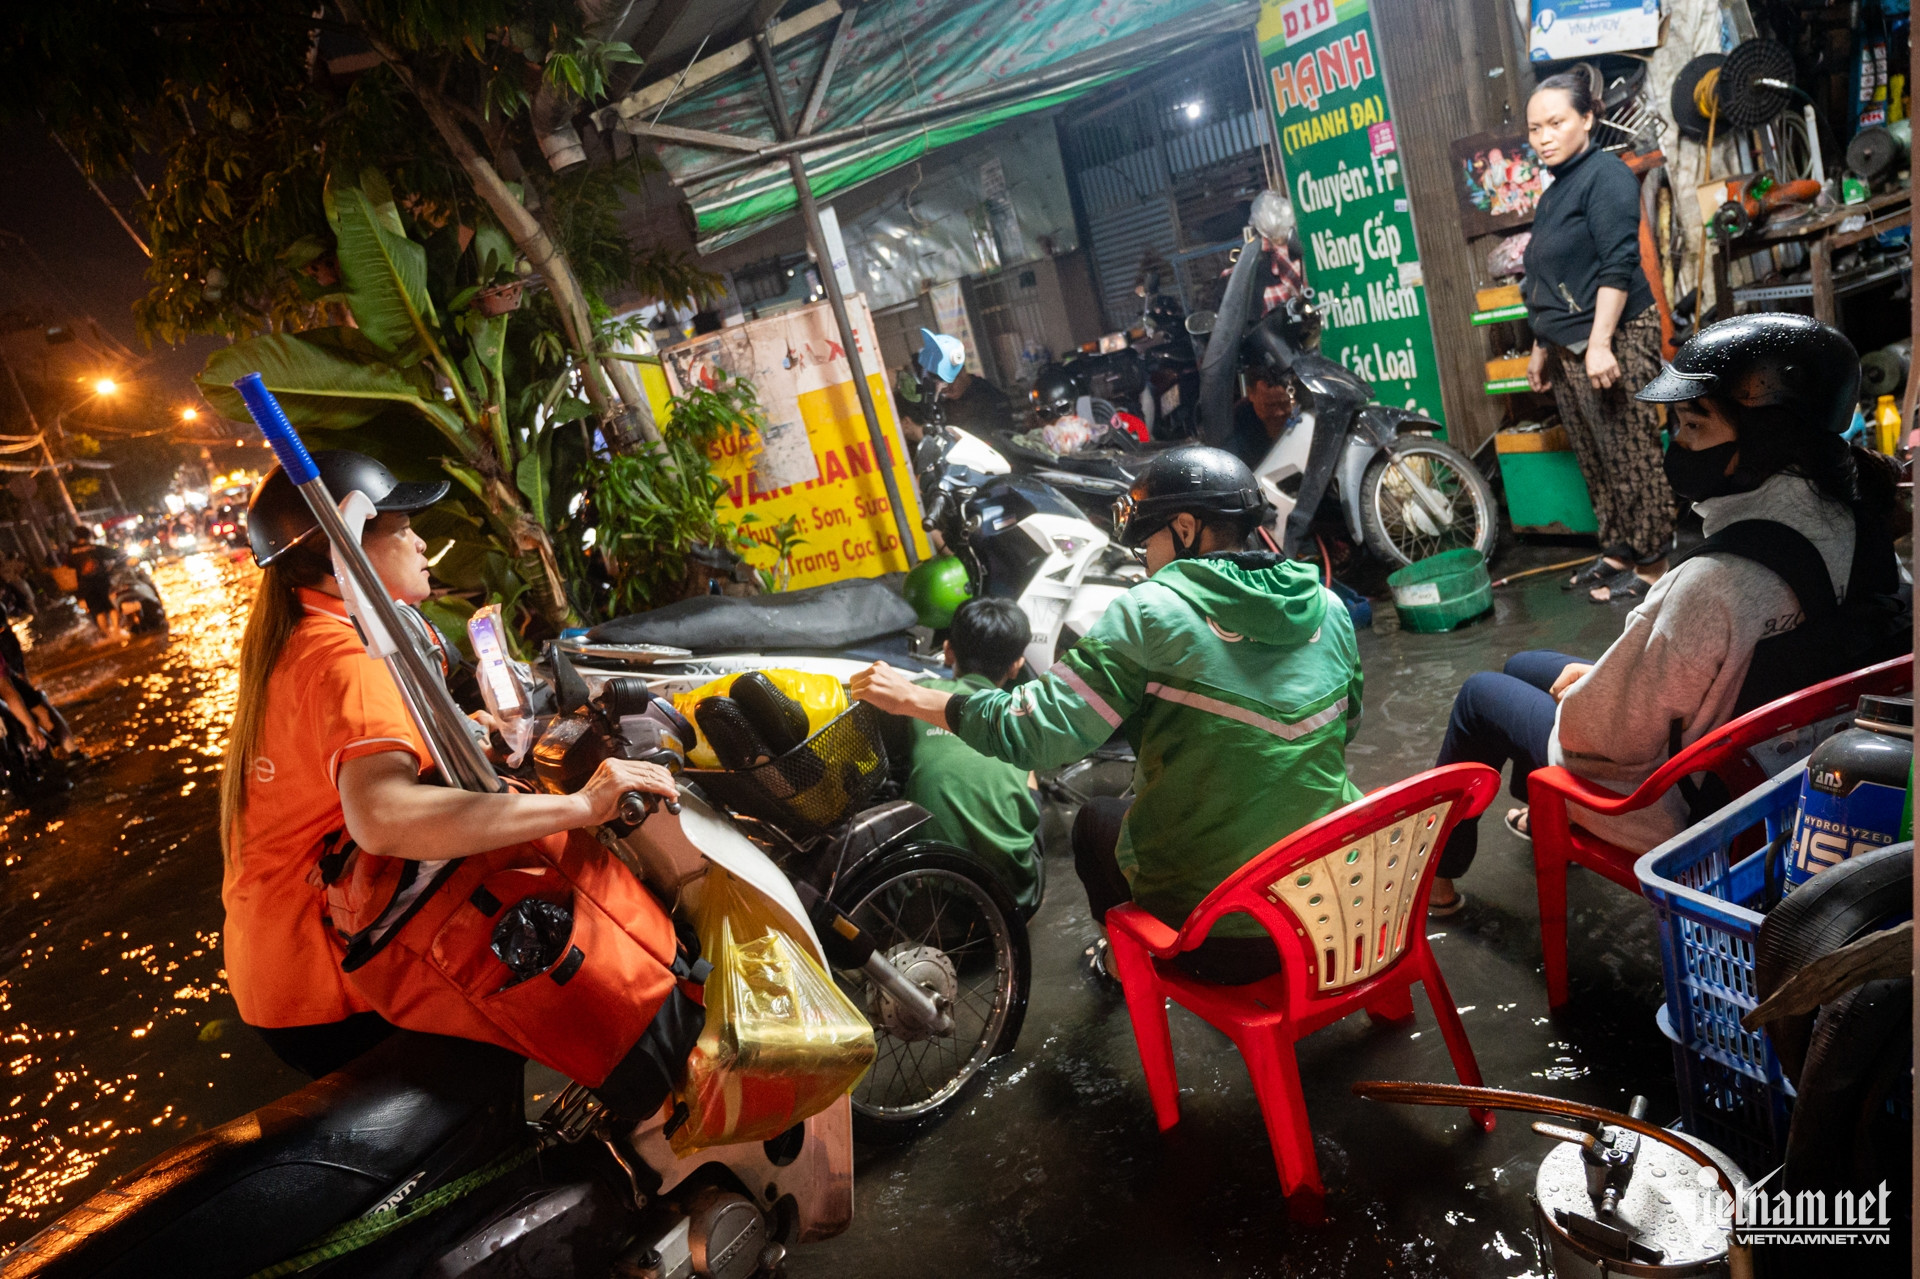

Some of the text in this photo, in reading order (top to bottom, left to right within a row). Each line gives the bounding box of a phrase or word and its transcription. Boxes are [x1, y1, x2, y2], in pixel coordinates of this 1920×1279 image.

[1271, 29, 1375, 117] HẠNH
[1283, 106, 1349, 155] (THANH
[1350, 95, 1384, 130] ĐA)
[1297, 160, 1373, 216] Chuyên:
[1310, 211, 1402, 275] Nâng Cấp
[1318, 273, 1419, 330] Phần Mềm
[1373, 338, 1418, 390] Loại
[1804, 814, 1893, 844] HYDROLYZED
